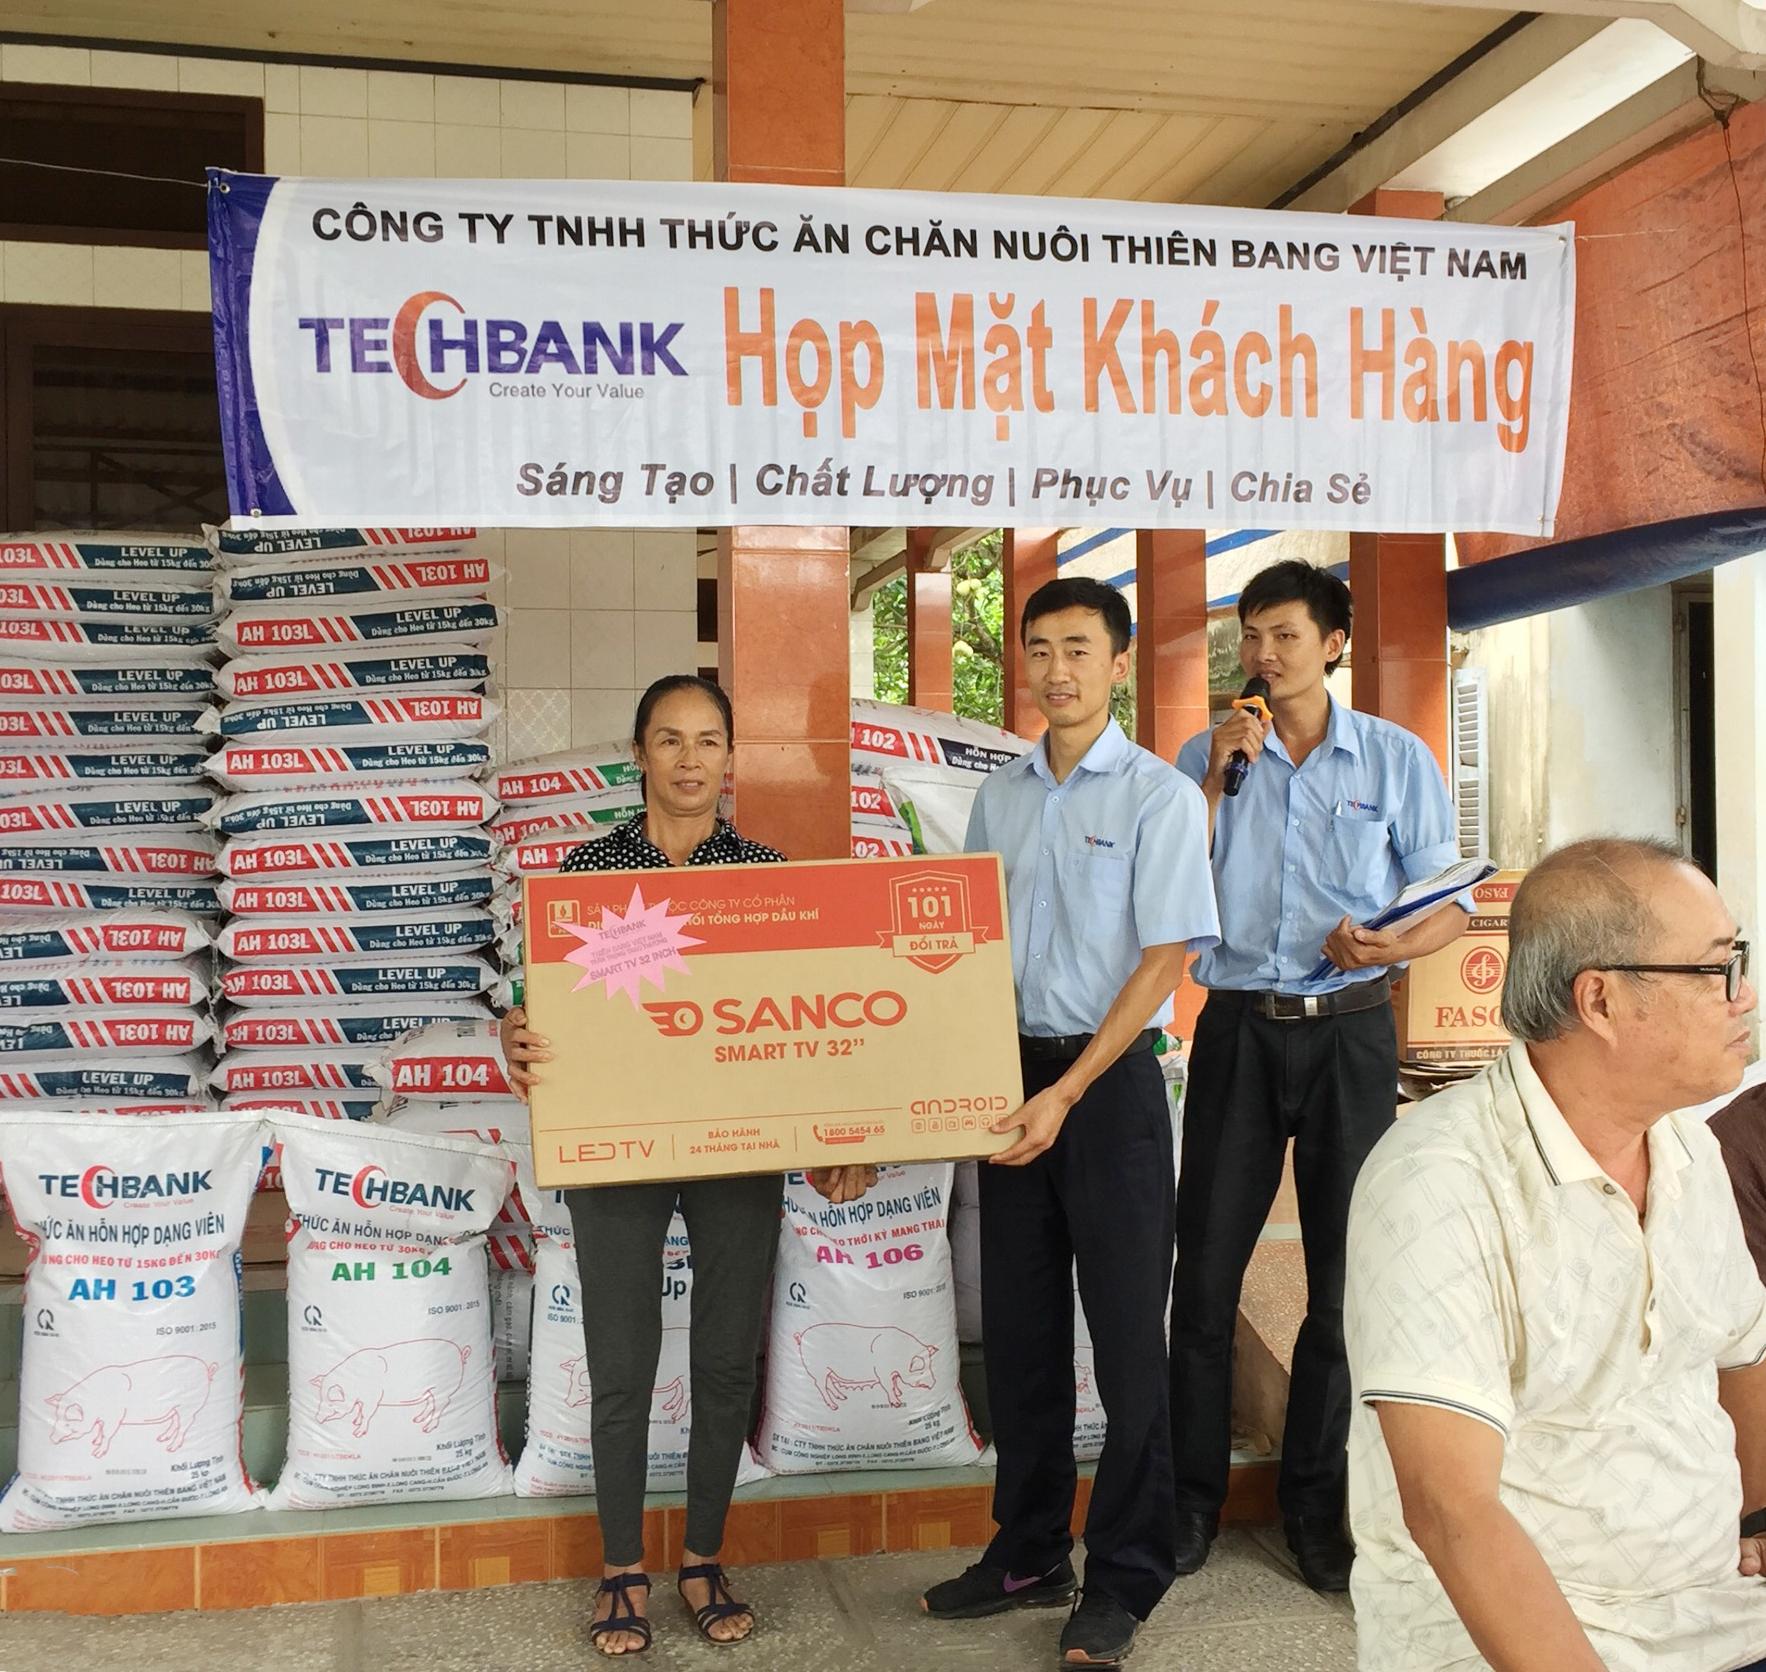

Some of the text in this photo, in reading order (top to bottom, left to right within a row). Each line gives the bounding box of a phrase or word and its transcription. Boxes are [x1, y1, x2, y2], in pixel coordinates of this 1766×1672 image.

[312, 202, 1527, 283] CÔNG TY TNHH THỨC ĂN CHĂN NUÔI THIÊN BANG VIỆT NAM
[298, 291, 688, 399] TECHBANK
[724, 287, 1534, 453] Họp Mặt Khách Hàng
[489, 381, 645, 399] Create Your Value
[517, 458, 1372, 507] Sáng Tạo Chất Lượng Phục Vụ Chia Sẻ
[121, 547, 188, 558] LEVEL UP
[416, 562, 486, 581] AH 103L
[266, 583, 335, 598] LEVEL UP
[396, 607, 462, 623] LEVEL UP
[241, 624, 314, 642] AH 103L
[371, 626, 392, 638] Dùng
[394, 624, 408, 634] cho
[410, 622, 424, 633] Heo
[437, 619, 457, 632] 15kg
[474, 616, 494, 628] 30kg
[118, 670, 184, 681] LEVEL UP
[861, 729, 896, 750] 102
[388, 744, 455, 756] LEVEL UP
[965, 747, 988, 759] HỖN
[230, 753, 304, 769] AH 103L
[952, 756, 988, 770] Dùng cho
[502, 777, 561, 796] AH 104
[851, 791, 882, 809] 102
[522, 847, 547, 864] AH
[690, 898, 726, 911] CÔNG
[729, 898, 741, 908] TY
[907, 895, 952, 918] 101
[708, 907, 819, 926] TỔNG HỢP DẦU KHÍ
[919, 920, 945, 930] NGÀY
[109, 930, 183, 946] AH 103L
[395, 923, 462, 937] LEVEL UP
[599, 920, 647, 940] TECHBANK
[237, 932, 310, 950] AH 103L
[936, 934, 959, 949] TRẢ
[590, 963, 623, 980] SMART
[624, 958, 637, 970] TV
[640, 954, 651, 965] 32
[652, 946, 677, 961] INCH
[113, 981, 187, 998] AH 103L
[713, 990, 908, 1035] SANCO
[714, 1042, 787, 1063] SMART
[793, 1041, 820, 1059] TV
[1416, 1048, 1442, 1060] CÔNG
[1445, 1050, 1457, 1059] TY
[396, 1064, 489, 1087] AH 104
[708, 1128, 761, 1139] BẢO HÀNH
[824, 1125, 885, 1137] 1800 5454 65
[690, 1146, 702, 1154] 24
[705, 1142, 738, 1154] THÁNG
[759, 1139, 780, 1151] NHÀ
[38, 1165, 213, 1210] TECHBANK
[315, 1165, 475, 1212] TECHBANK
[848, 1203, 874, 1225] HỢP
[878, 1199, 912, 1220] DẠNG
[913, 1186, 942, 1211] VIÊN
[66, 1211, 225, 1248] ĂN HỖN HỢP DẠNG VIÊN
[332, 1217, 351, 1235] ĂN
[354, 1219, 382, 1239] HỖN
[385, 1229, 412, 1241] HỢP
[848, 1233, 872, 1246] THỜI
[891, 1224, 920, 1238] MANG
[330, 1241, 351, 1249] CHO
[65, 1254, 89, 1265] CHO
[92, 1256, 114, 1267] HEO
[137, 1258, 167, 1269] 15KG
[817, 1244, 924, 1269] AH 106
[331, 1257, 452, 1281] AH 104
[69, 1275, 196, 1301] AH 103
[428, 1303, 463, 1315] ISO 9001
[156, 1325, 195, 1336] ISO 9001
